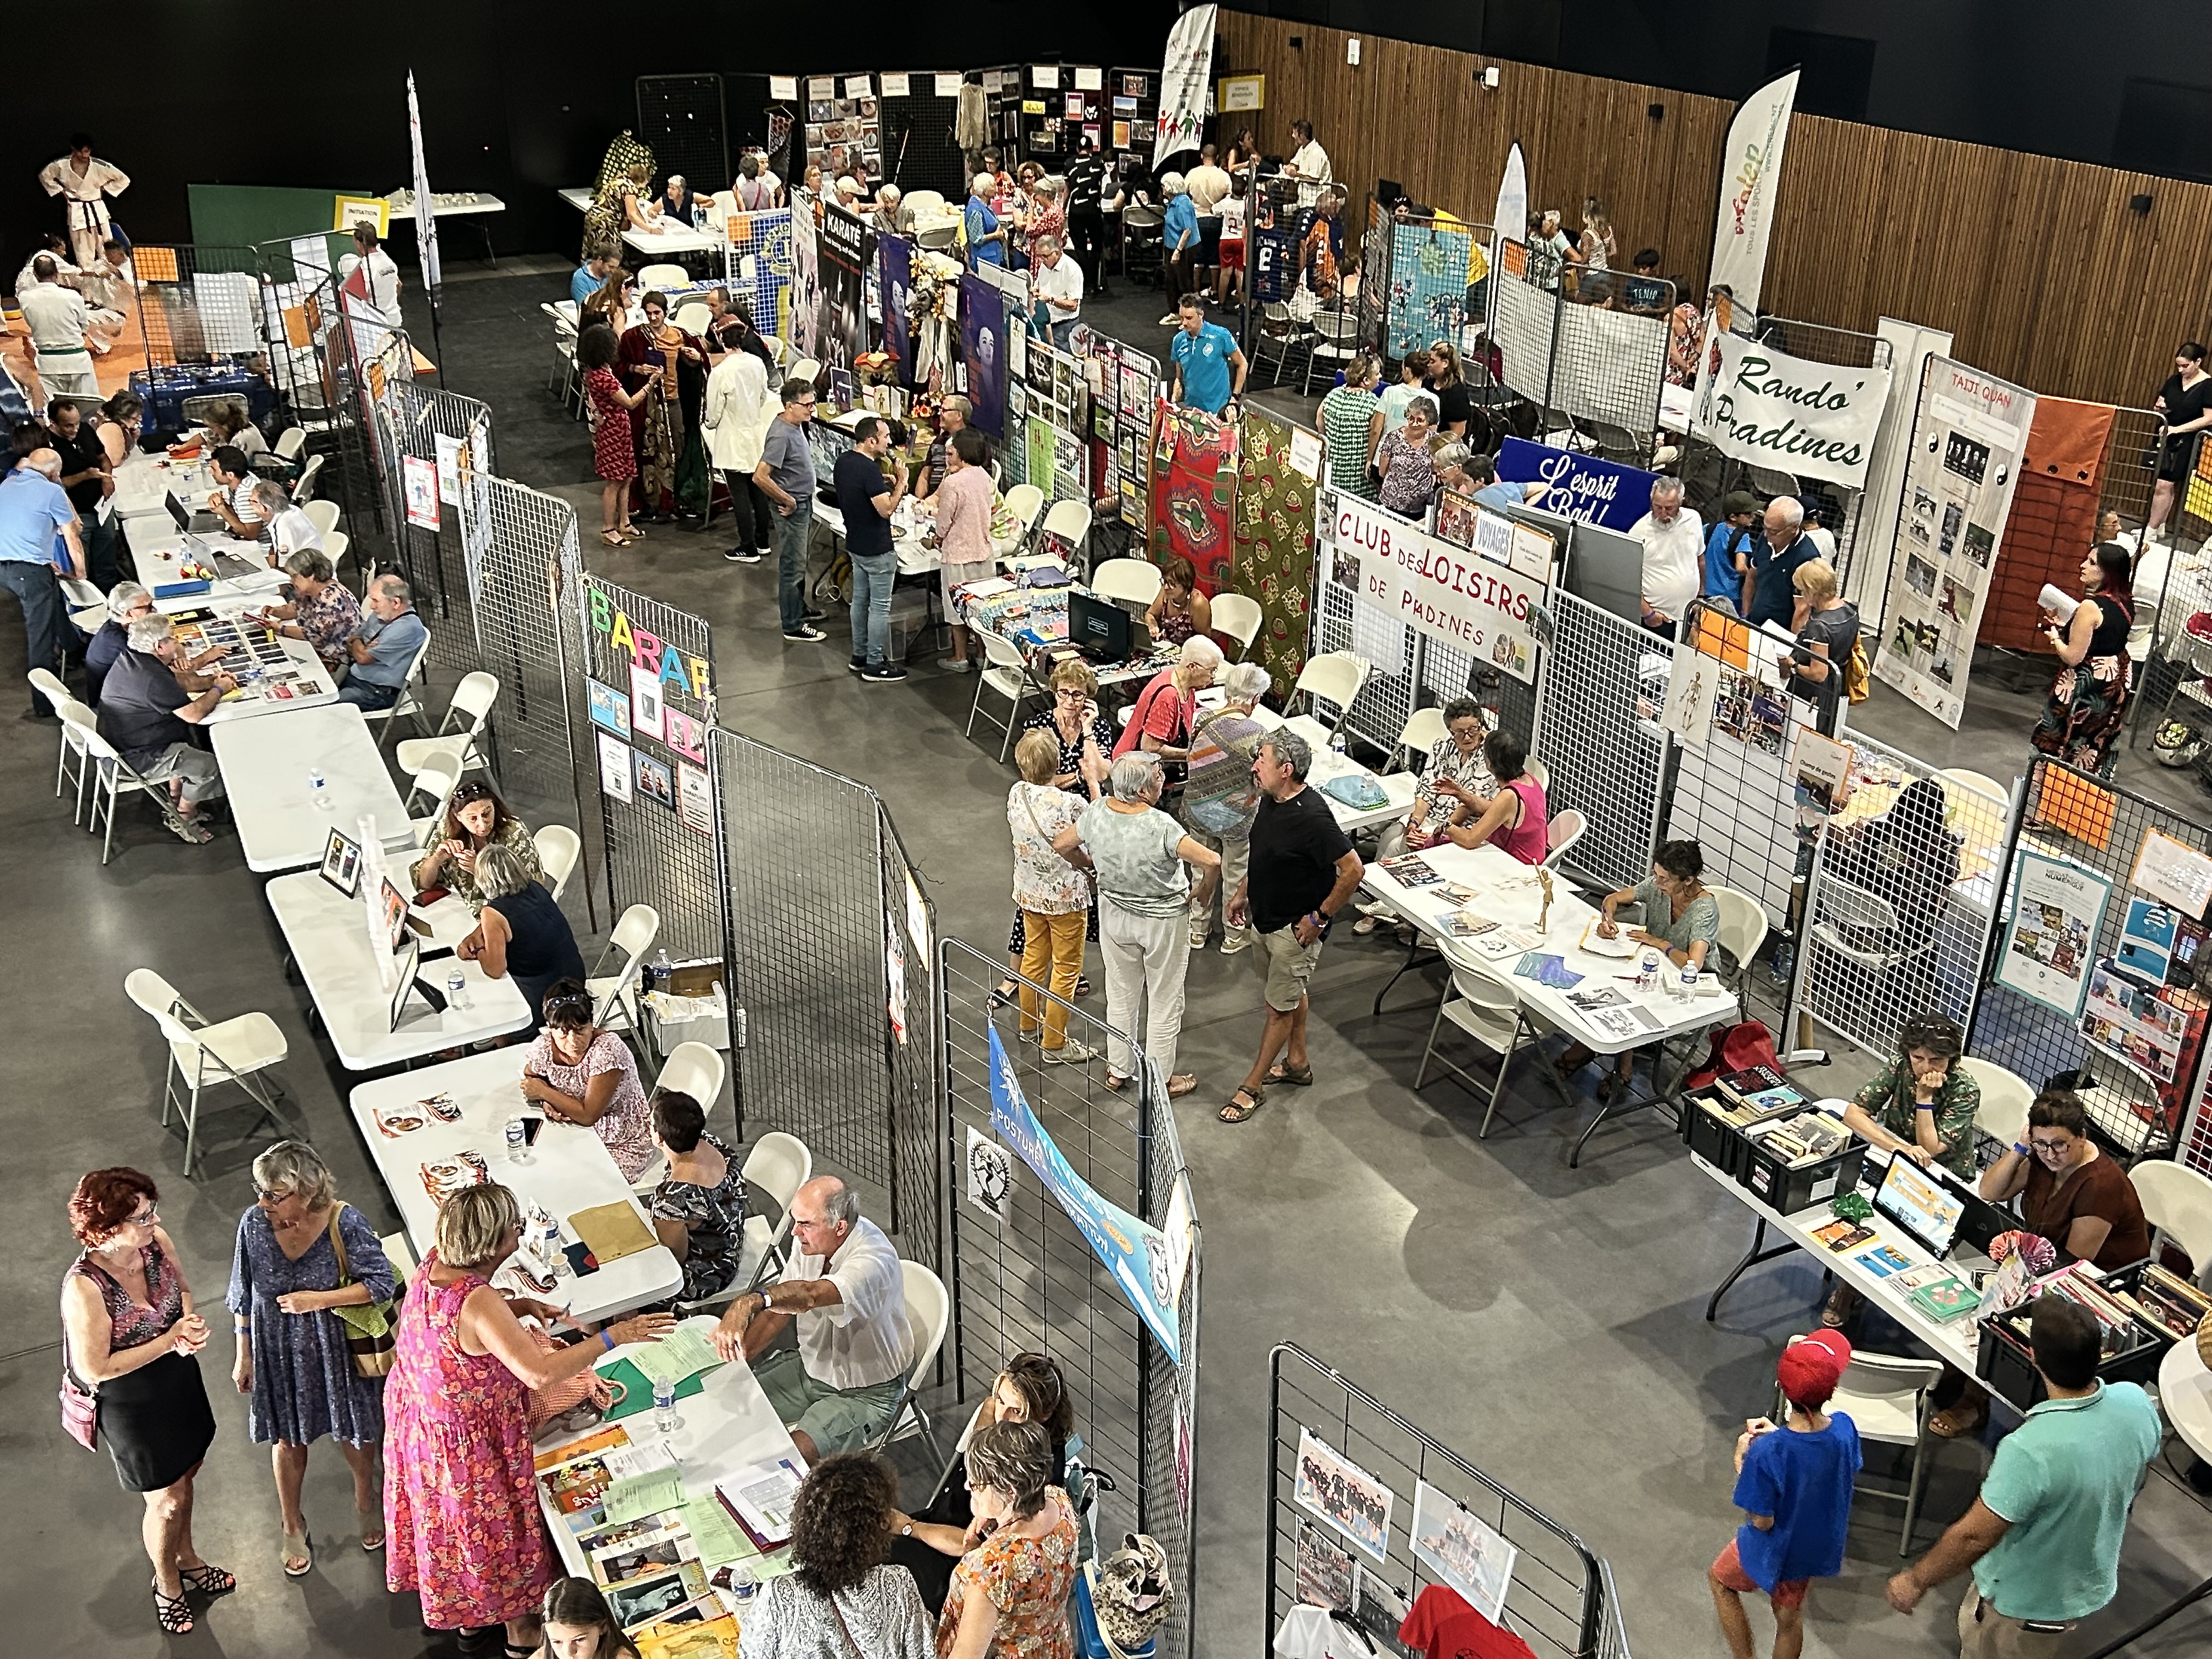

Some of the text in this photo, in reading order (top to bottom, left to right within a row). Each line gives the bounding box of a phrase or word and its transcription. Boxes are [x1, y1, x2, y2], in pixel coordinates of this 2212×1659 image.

[827, 212, 861, 247] KARATÉ
[1228, 217, 1238, 235] 2
[1750, 208, 1759, 228] LES
[1746, 233, 1756, 256] TOUS
[1734, 356, 1865, 410] Rando'
[1953, 373, 2012, 408] TAIJI QUAN
[1714, 393, 1864, 466] Pradines
[1539, 454, 1620, 504] L'esprit
[1548, 488, 1598, 523] Bad
[1477, 518, 1510, 557] VOYAGES
[1339, 513, 1529, 622] CLUB DES LOISIRS
[1369, 574, 1387, 600] DE
